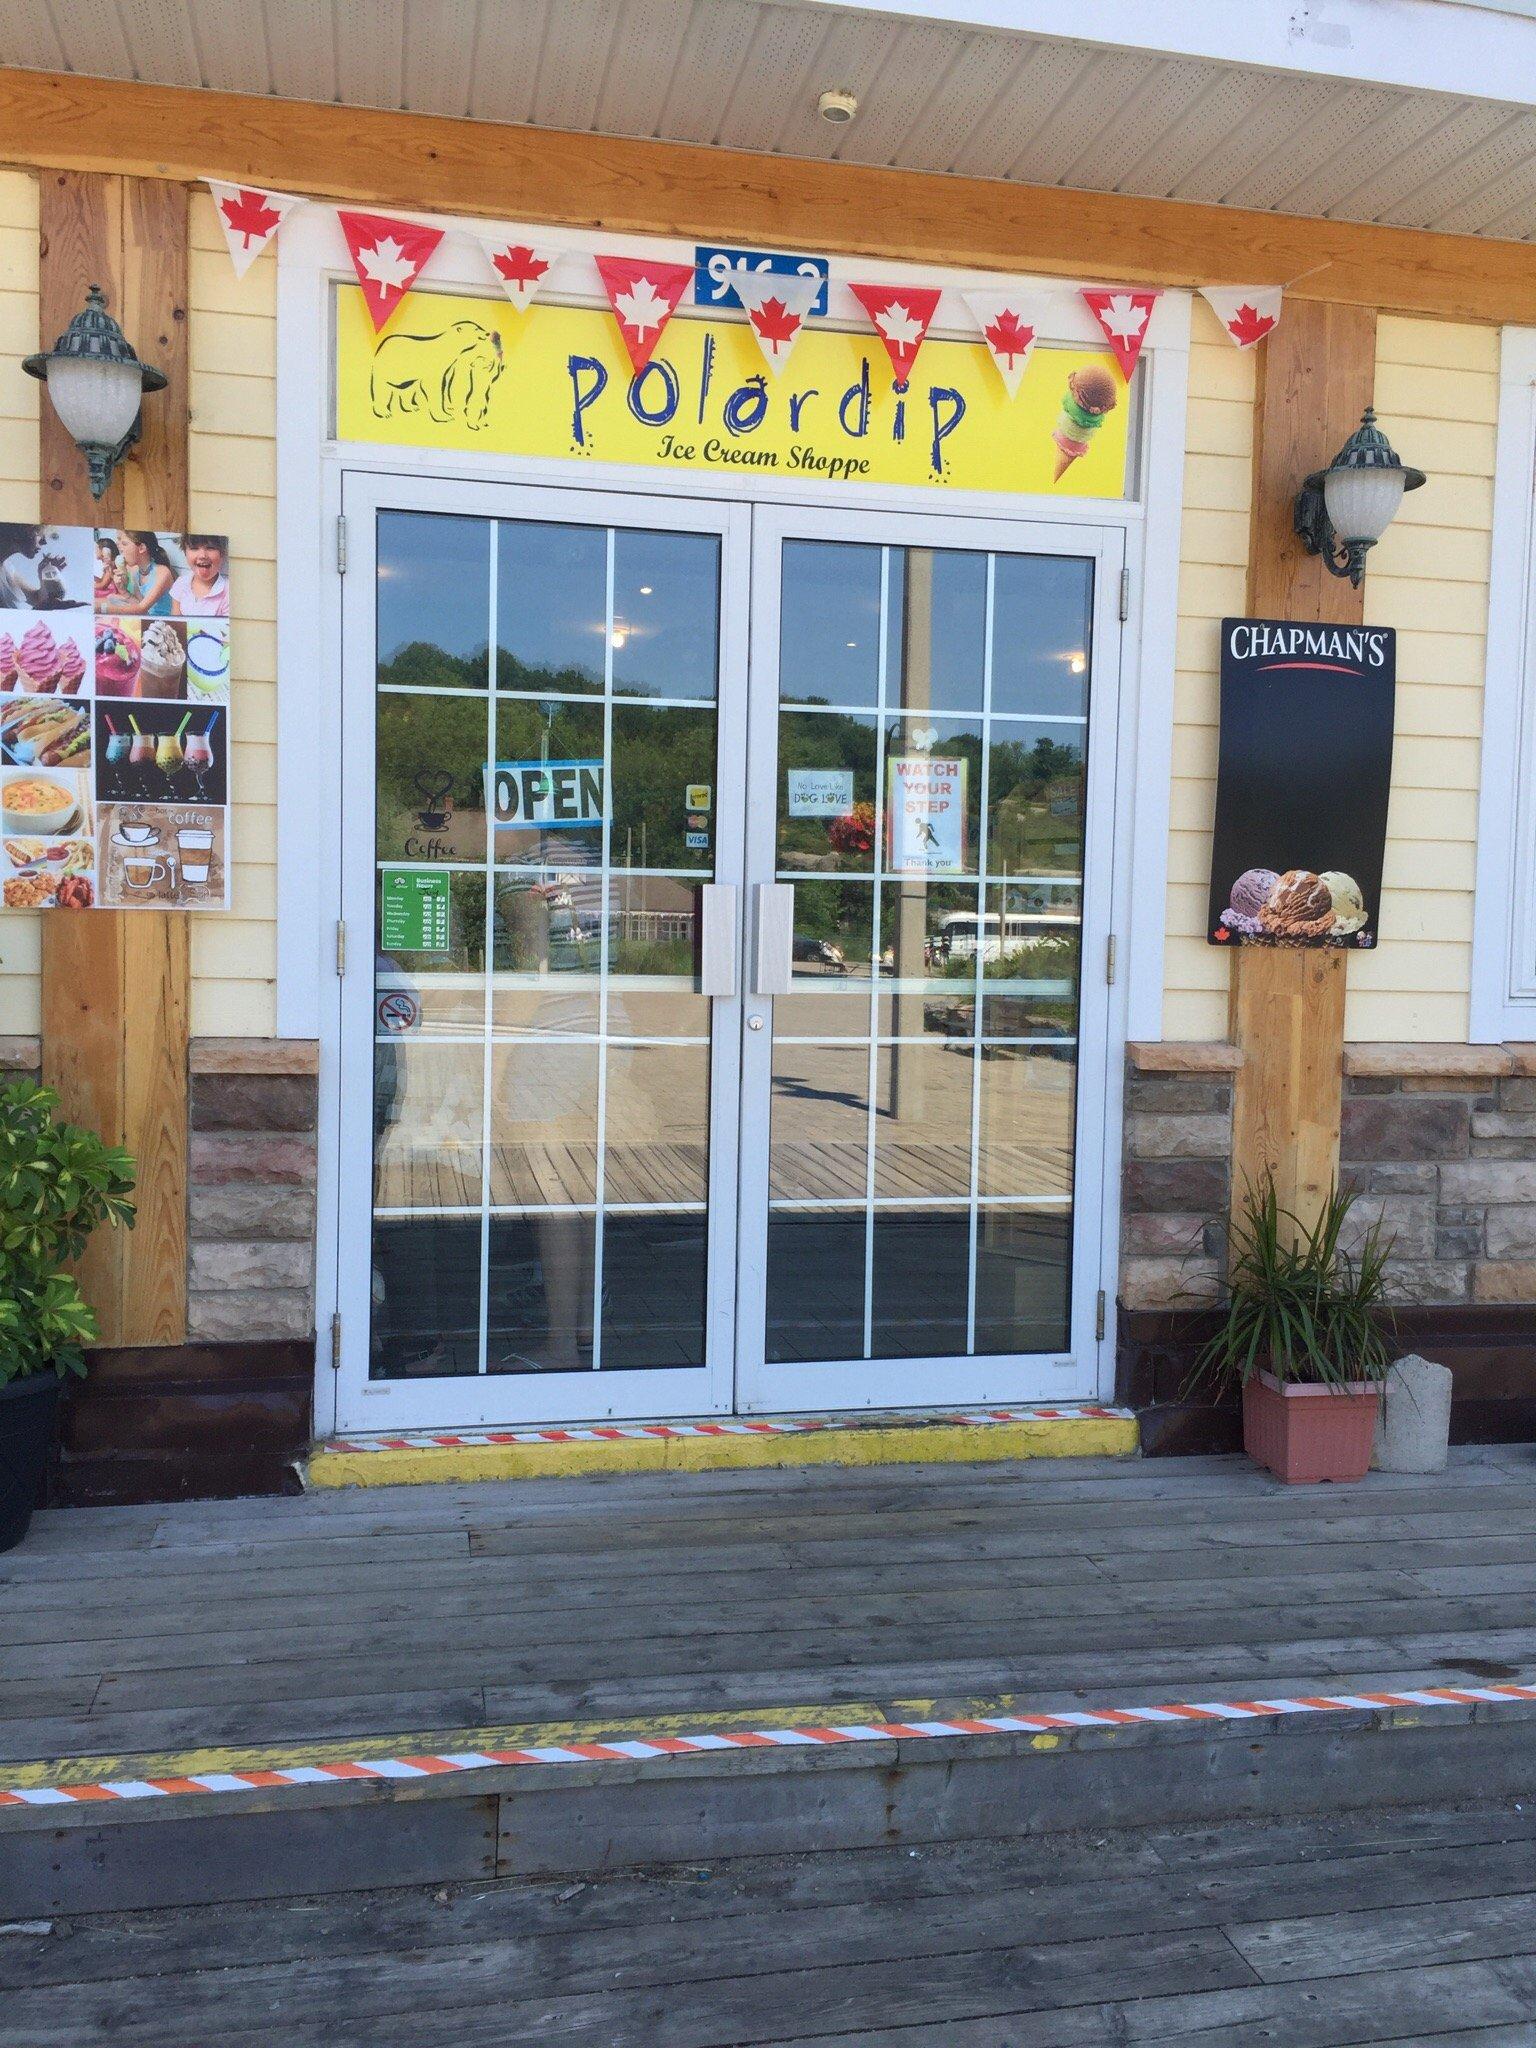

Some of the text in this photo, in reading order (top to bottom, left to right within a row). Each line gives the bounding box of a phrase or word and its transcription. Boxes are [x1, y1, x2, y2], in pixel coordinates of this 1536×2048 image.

[657, 435, 871, 480] Ice Cream Shoppe
[896, 763, 958, 777] WATCH
[797, 782, 808, 790] No
[903, 782, 952, 795] YOUR
[494, 769, 605, 822] OPEN
[905, 801, 950, 813] STEP
[168, 812, 214, 825] coffee
[688, 836, 708, 844] VISA
[404, 837, 457, 859] Coffee
[905, 859, 952, 868] Thank you
